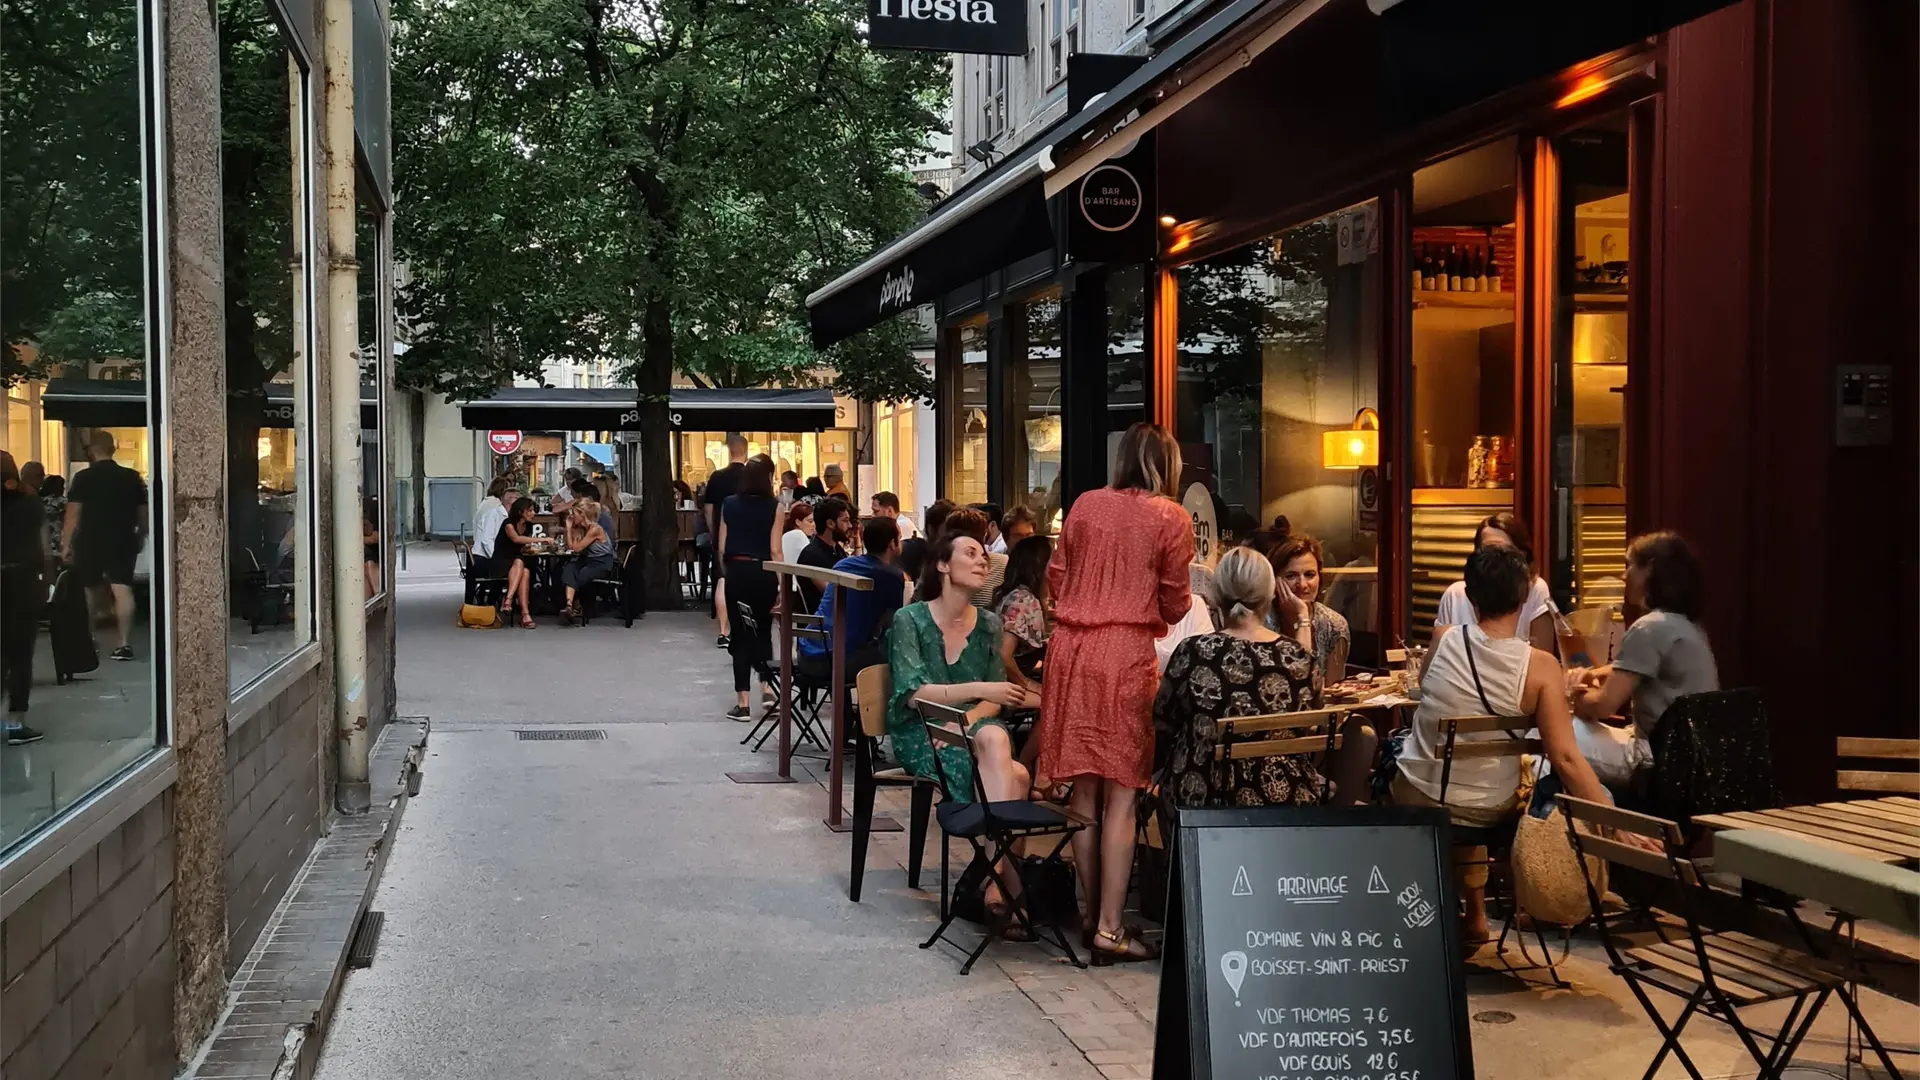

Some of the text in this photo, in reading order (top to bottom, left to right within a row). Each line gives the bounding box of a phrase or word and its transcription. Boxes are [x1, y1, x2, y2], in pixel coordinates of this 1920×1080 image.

[1102, 187, 1120, 195] BAR
[1085, 197, 1137, 206] D'ARTISANS
[1221, 529, 1234, 541] BAR
[1278, 873, 1349, 896] ARRIVAGE
[1397, 882, 1422, 907] 100%
[1403, 901, 1436, 928] LOCAL
[1246, 929, 1304, 948] DOMAINE
[1311, 929, 1336, 947] VIN
[1341, 930, 1353, 947] &
[1357, 929, 1383, 948] PIC
[1256, 1008, 1286, 1024] VDF
[1291, 1007, 1351, 1024] THOMAS
[1238, 1032, 1268, 1048] VDF
[1274, 1028, 1368, 1049] D'AUTREFOIS
[1279, 1055, 1308, 1071] VDF
